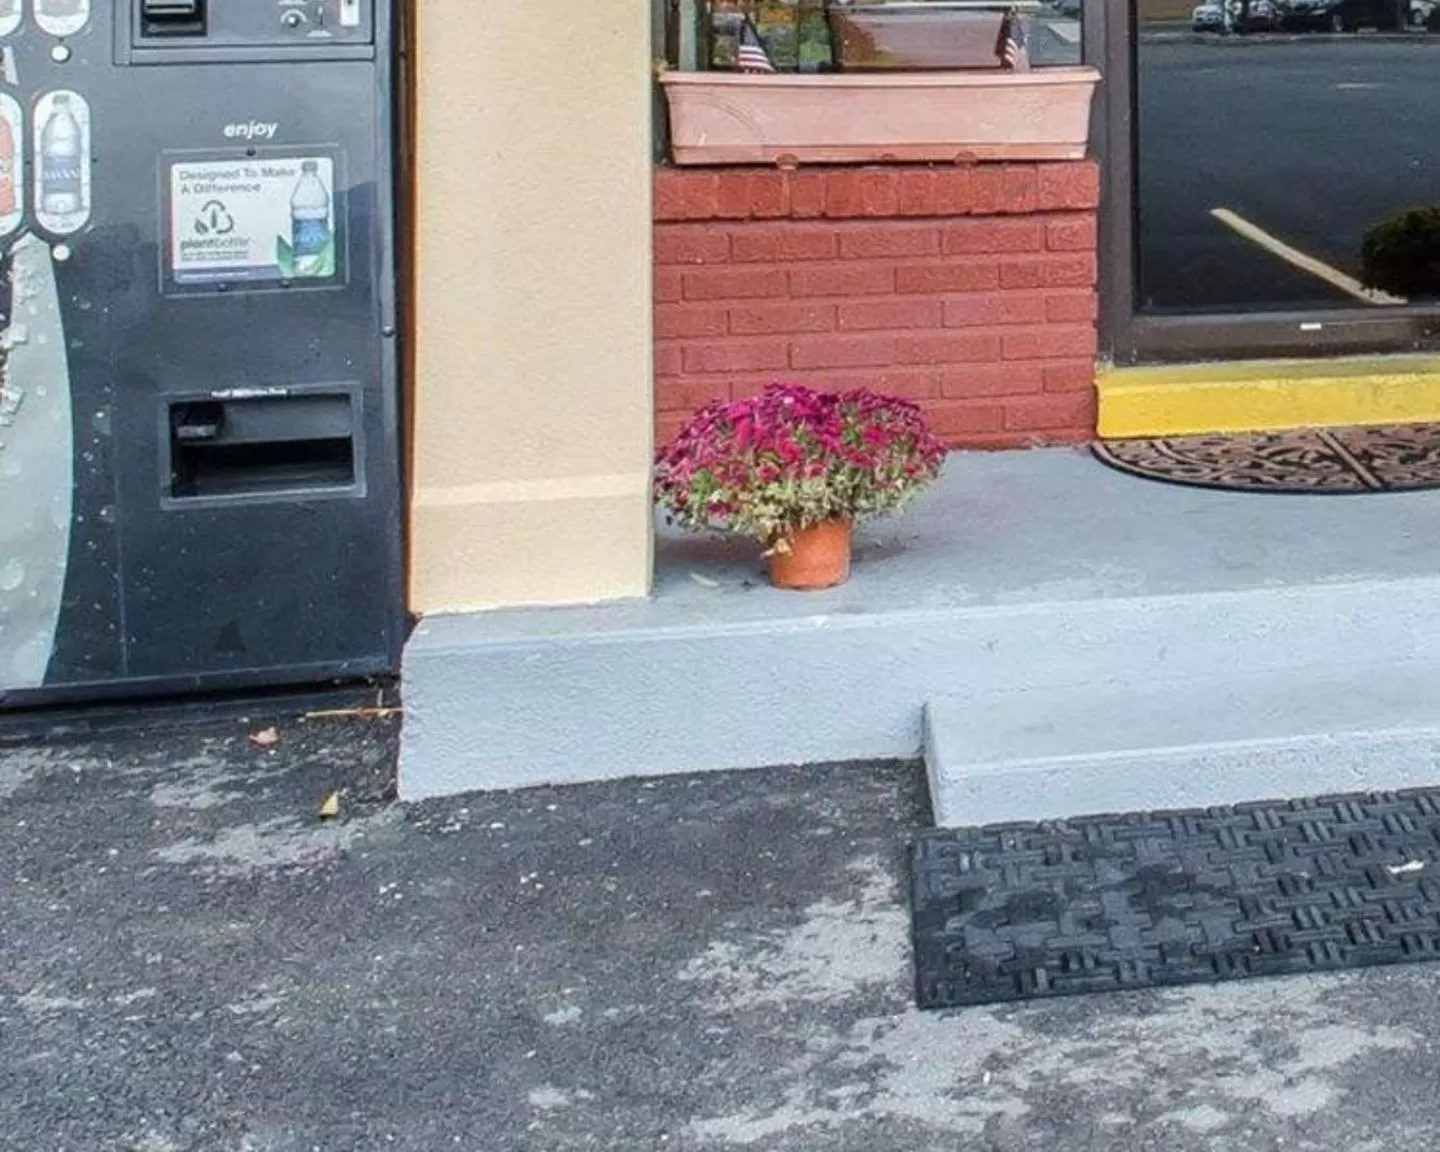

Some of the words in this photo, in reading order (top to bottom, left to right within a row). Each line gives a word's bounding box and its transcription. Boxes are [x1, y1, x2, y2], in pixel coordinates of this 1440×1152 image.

[223, 119, 279, 140] enjoy
[179, 168, 240, 182] Designed
[243, 168, 258, 177] To
[260, 166, 295, 177] Make
[181, 185, 190, 194] A
[194, 183, 261, 194] Difference
